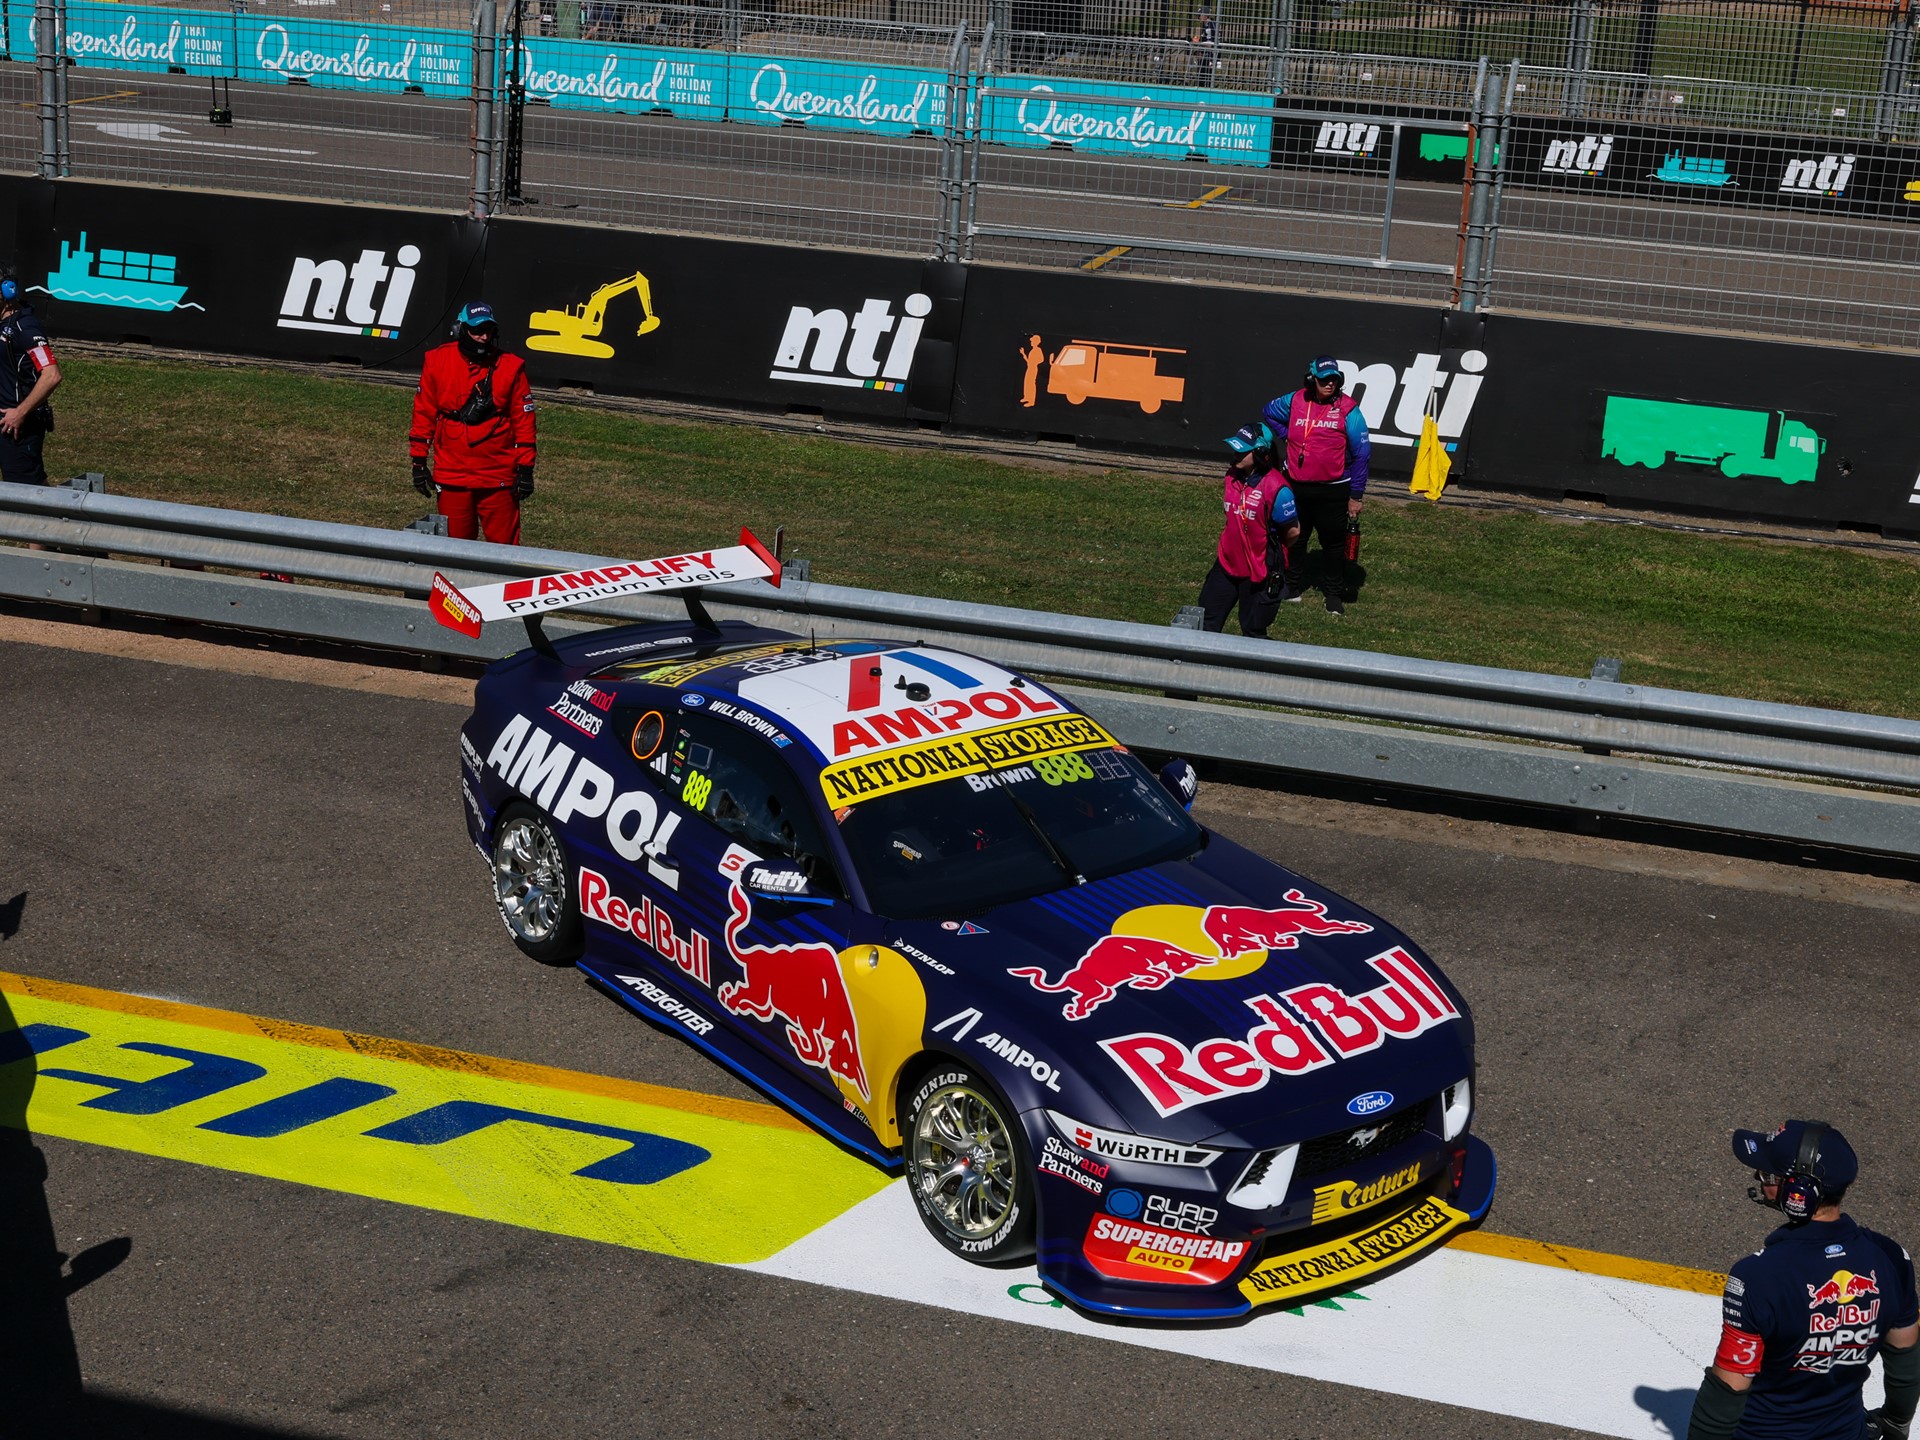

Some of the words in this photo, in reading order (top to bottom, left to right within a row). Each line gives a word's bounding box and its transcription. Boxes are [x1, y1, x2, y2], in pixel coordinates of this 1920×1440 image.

[184, 39, 222, 52] HOLIDAY
[185, 26, 206, 37] THAT
[421, 43, 444, 56] THAT
[184, 53, 222, 66] FEELING
[256, 24, 417, 84] Queensland
[420, 57, 460, 71] HOLIDAY
[671, 62, 695, 77] THAT
[420, 71, 460, 85] FEELING
[670, 77, 712, 92] HOLIDAY
[750, 63, 928, 128] Queensland
[669, 92, 711, 105] FEELING
[1018, 84, 1206, 151] Queensland
[1208, 120, 1257, 136] HOLIDAY
[1208, 136, 1254, 152] FEELING
[1543, 134, 1613, 171] nti
[1781, 153, 1856, 191] nti
[280, 244, 421, 327] nti
[773, 293, 932, 380] nti
[1336, 350, 1488, 438] nti
[1296, 418, 1310, 428] PIT
[1312, 419, 1339, 429] LANE
[506, 581, 643, 613] Premium
[656, 569, 736, 587] Fuels
[539, 552, 716, 595] AMPLIFY
[434, 576, 480, 623] SUPERCHEAP
[445, 600, 461, 618] AUTO
[549, 692, 603, 735] Partners
[709, 701, 737, 717] WILL
[734, 709, 779, 738] BROWN
[833, 688, 1060, 757] AMPOL
[825, 741, 987, 801] NATIONAL
[984, 719, 1100, 761] STORAGE
[964, 765, 1037, 793] Brown
[1032, 752, 1094, 786] 888
[487, 713, 682, 891] AMPOL
[682, 770, 712, 811] 888
[749, 867, 808, 892] Thrifty
[762, 884, 788, 892] RENTAL
[901, 943, 955, 976] DUNLOP
[626, 975, 714, 1035] FREIGHTER
[976, 1032, 1061, 1093] AMPOL
[913, 1072, 968, 1113] DUNLOP
[1354, 1093, 1389, 1113] Ford
[1097, 1137, 1179, 1163] WÜRTH
[1038, 1152, 1103, 1194] Partners
[1147, 1195, 1219, 1223] QUAD
[1312, 1162, 1421, 1225] Century
[994, 1202, 1020, 1246] SPORT
[1093, 1218, 1244, 1263] SUPERCHEAP
[1143, 1209, 1215, 1236] LOCK
[960, 1239, 993, 1252] MAXX
[1134, 1251, 1185, 1268] AUTO
[1248, 1247, 1368, 1292] NATIONAL
[1357, 1203, 1446, 1259] STORAGE
[1733, 1339, 1756, 1365] 3
